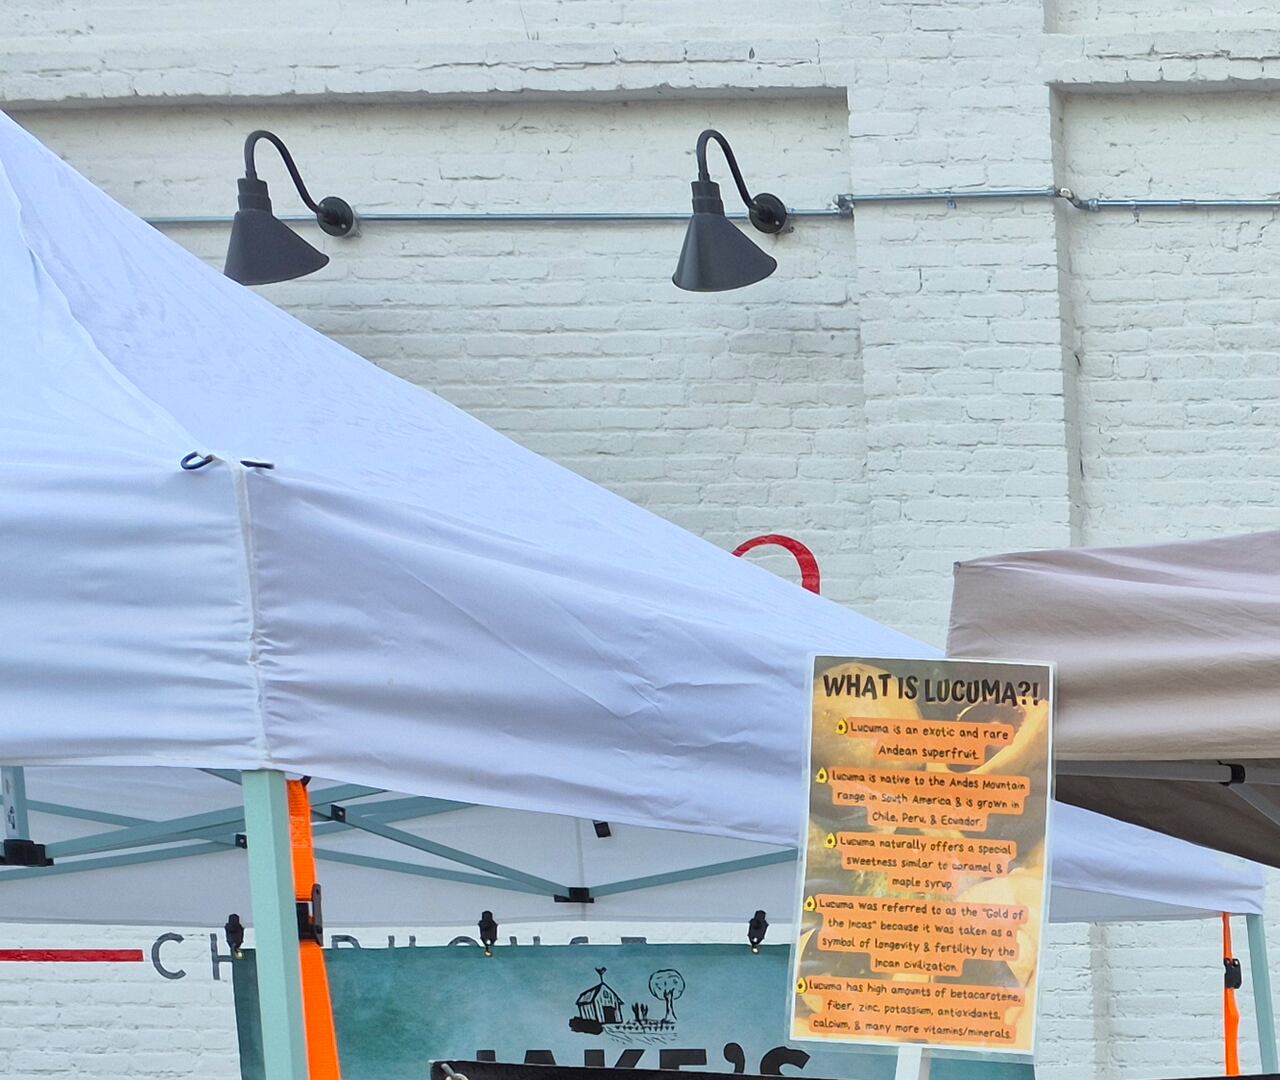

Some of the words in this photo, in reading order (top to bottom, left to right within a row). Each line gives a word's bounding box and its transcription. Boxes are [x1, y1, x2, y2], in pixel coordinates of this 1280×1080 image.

[823, 674, 891, 699] WHAT
[898, 677, 917, 700] IS
[924, 678, 1040, 707] LUCUMA?!
[850, 722, 888, 734] Lucuma
[893, 724, 901, 735] is
[905, 726, 918, 735] an
[923, 726, 955, 738] exotic
[959, 727, 978, 738] and
[984, 730, 1009, 740] rare
[878, 744, 918, 756] Andean
